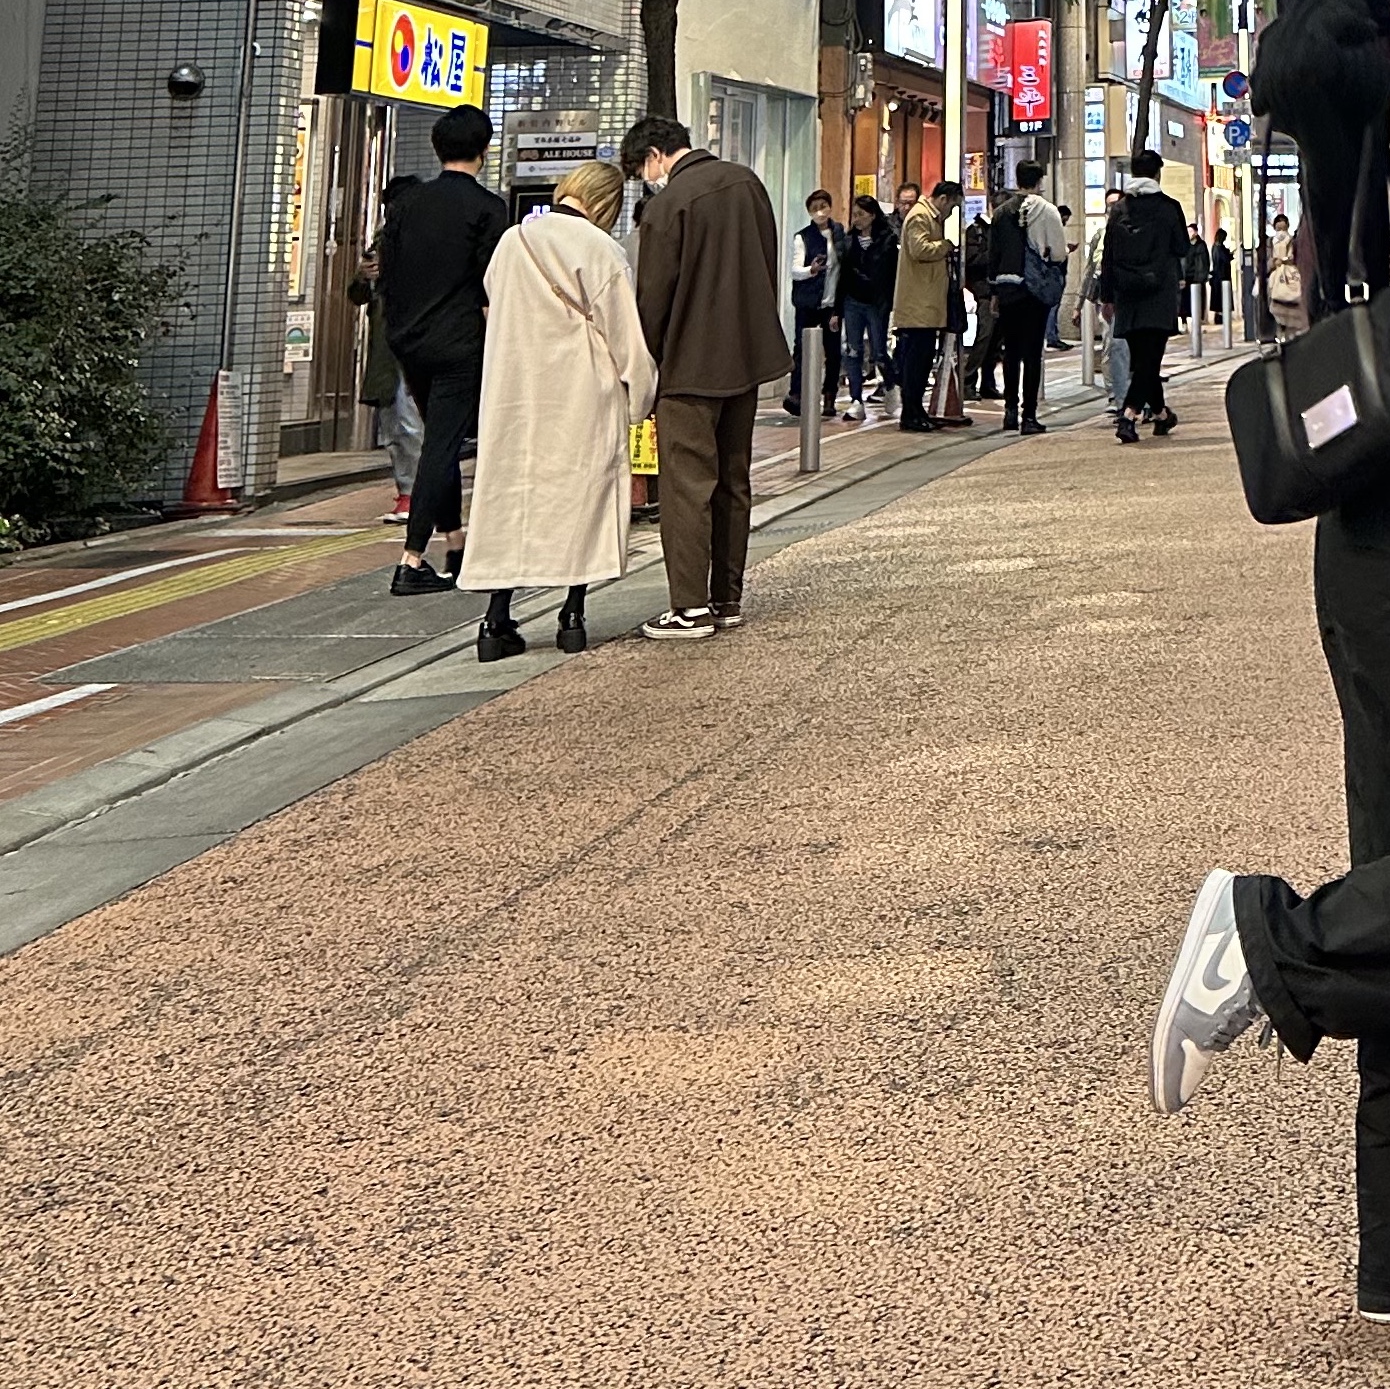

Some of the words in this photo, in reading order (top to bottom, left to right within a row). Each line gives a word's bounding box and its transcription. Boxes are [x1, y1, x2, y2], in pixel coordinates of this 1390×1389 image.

[420, 27, 467, 93] 松屋
[543, 150, 560, 159] ALE
[563, 149, 595, 158] HOUSE
